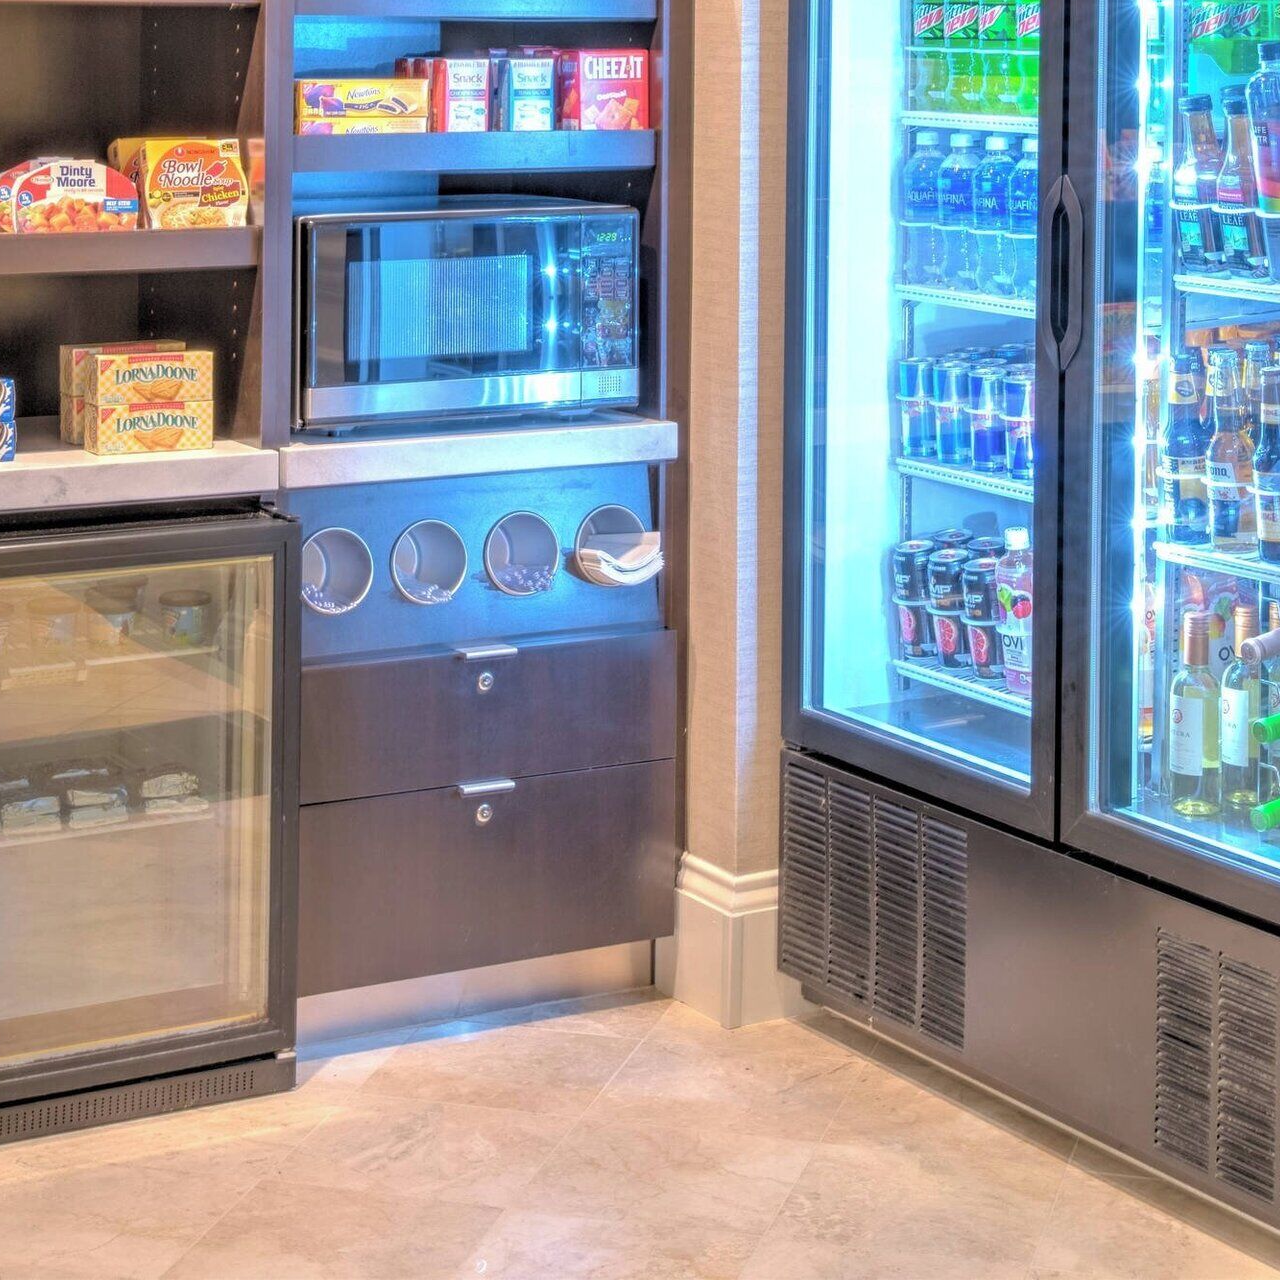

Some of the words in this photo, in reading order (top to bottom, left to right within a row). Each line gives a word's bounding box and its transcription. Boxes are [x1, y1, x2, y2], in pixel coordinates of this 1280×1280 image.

[453, 73, 483, 83] Snack
[517, 73, 547, 83] Snack
[346, 88, 381, 100] Newtons
[1254, 126, 1266, 134] IFE
[59, 165, 93, 178] Dinty
[162, 158, 203, 174] Bowl
[57, 177, 96, 188] Moore
[159, 173, 213, 187] Noodle
[201, 190, 240, 202] Chicken
[906, 190, 937, 202] AQUAFI
[115, 367, 157, 385] LORNA
[156, 364, 198, 381] DOONE
[116, 415, 158, 433] LORNA
[156, 412, 199, 430] DOONE
